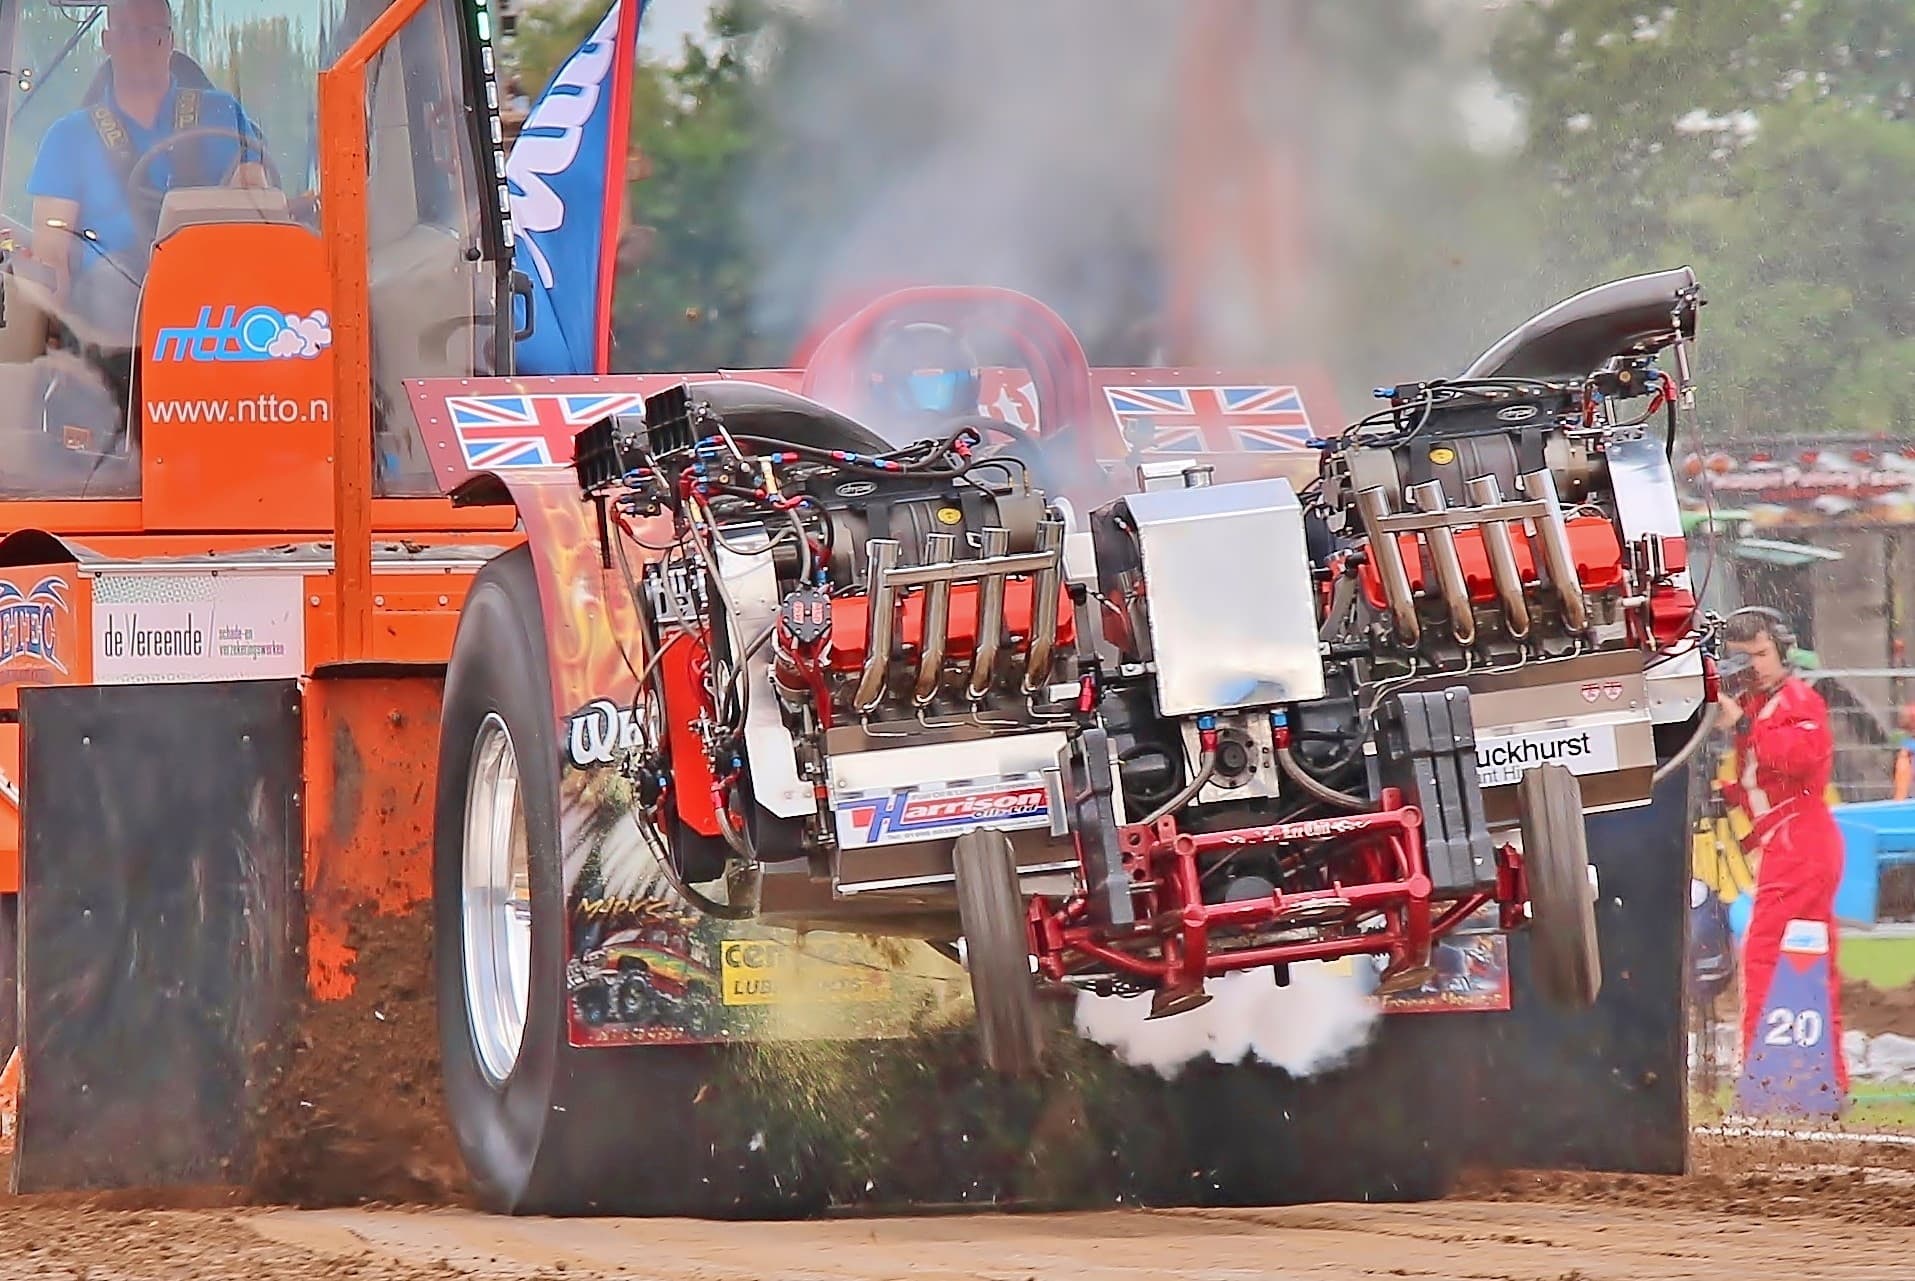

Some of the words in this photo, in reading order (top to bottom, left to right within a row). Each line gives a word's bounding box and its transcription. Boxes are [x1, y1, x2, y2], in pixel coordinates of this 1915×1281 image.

[147, 393, 329, 423] www.ntto.n
[0, 603, 56, 659] ETEC
[105, 613, 123, 657] de
[125, 612, 202, 657] Vereende
[1475, 732, 1591, 768] uckhurst
[1503, 765, 1522, 781] Hi
[1764, 1006, 1824, 1048] 20
